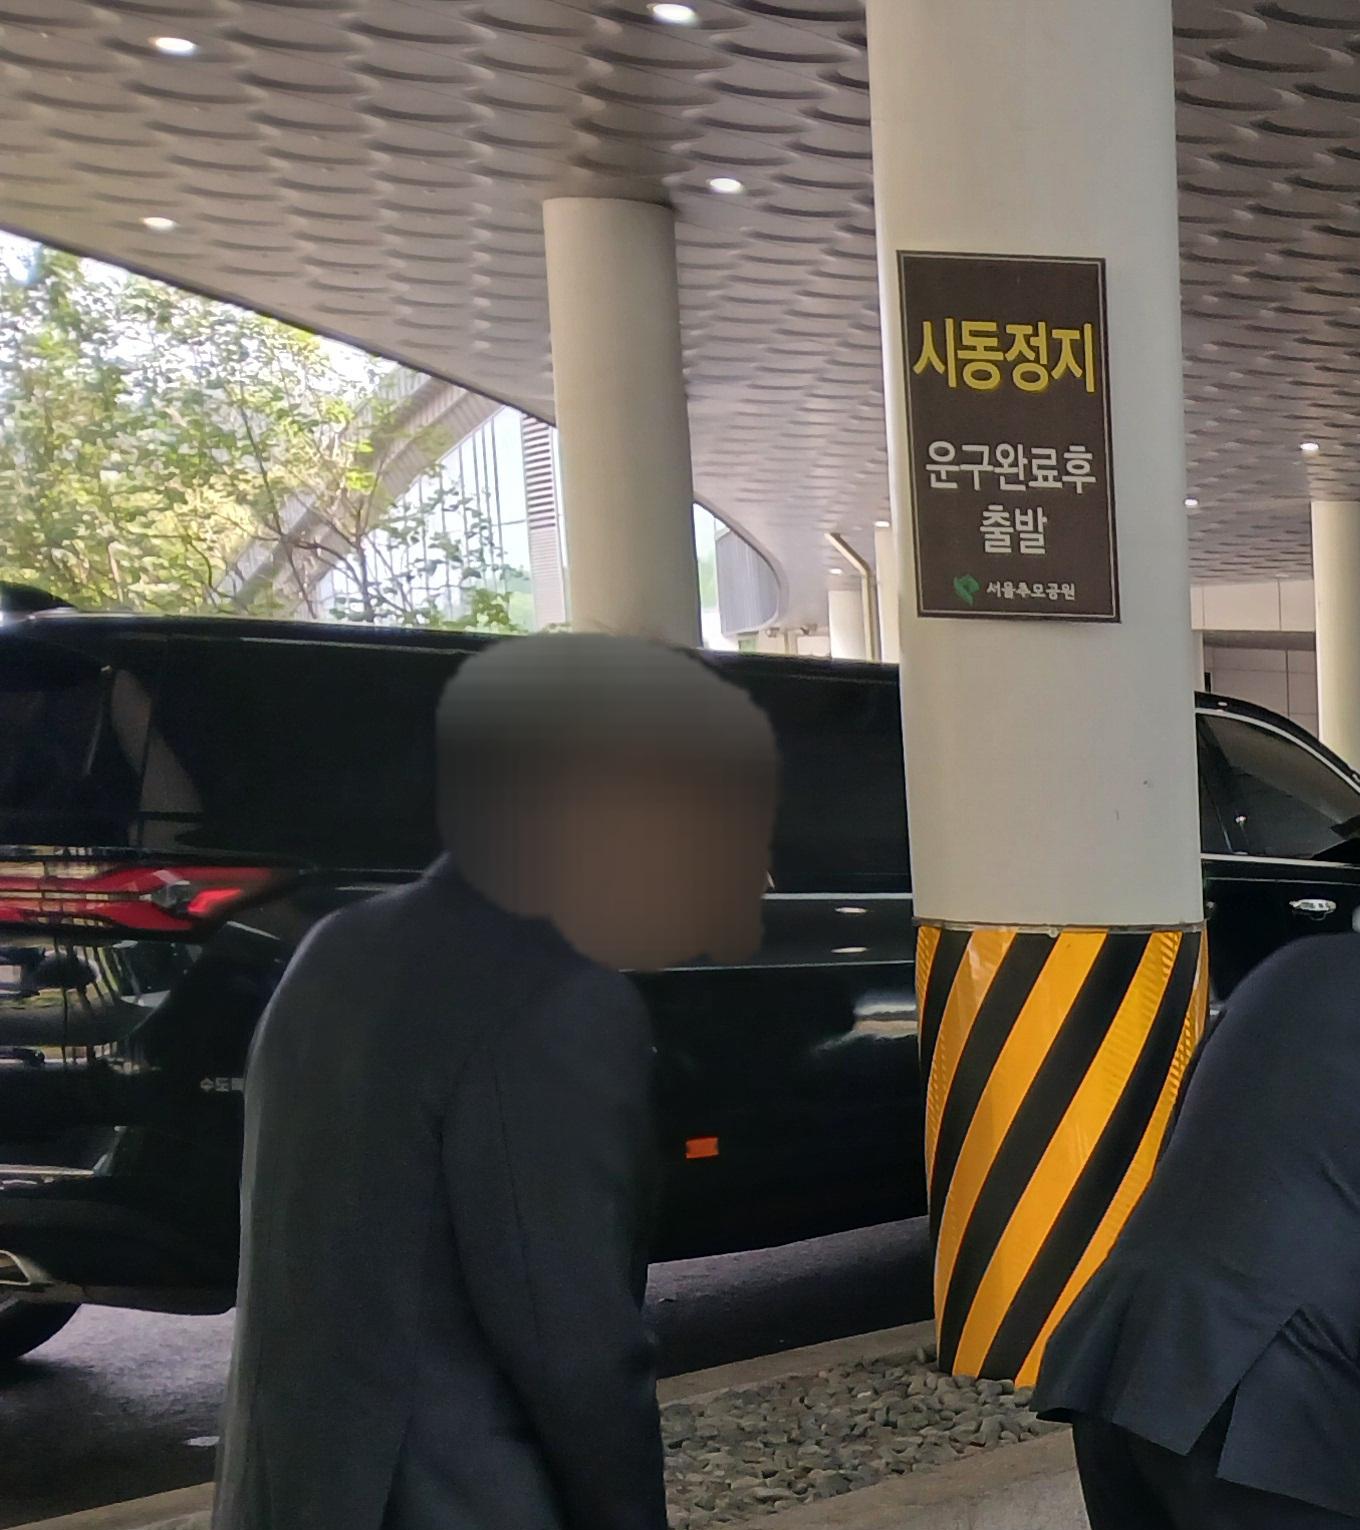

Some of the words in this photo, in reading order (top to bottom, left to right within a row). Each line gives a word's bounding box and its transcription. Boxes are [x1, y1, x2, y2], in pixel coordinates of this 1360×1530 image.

[913, 318, 1096, 393] 시동정지
[925, 440, 1097, 494] 운구완료후
[979, 504, 1048, 555] 출발
[986, 580, 1076, 601] 서울추모공원
